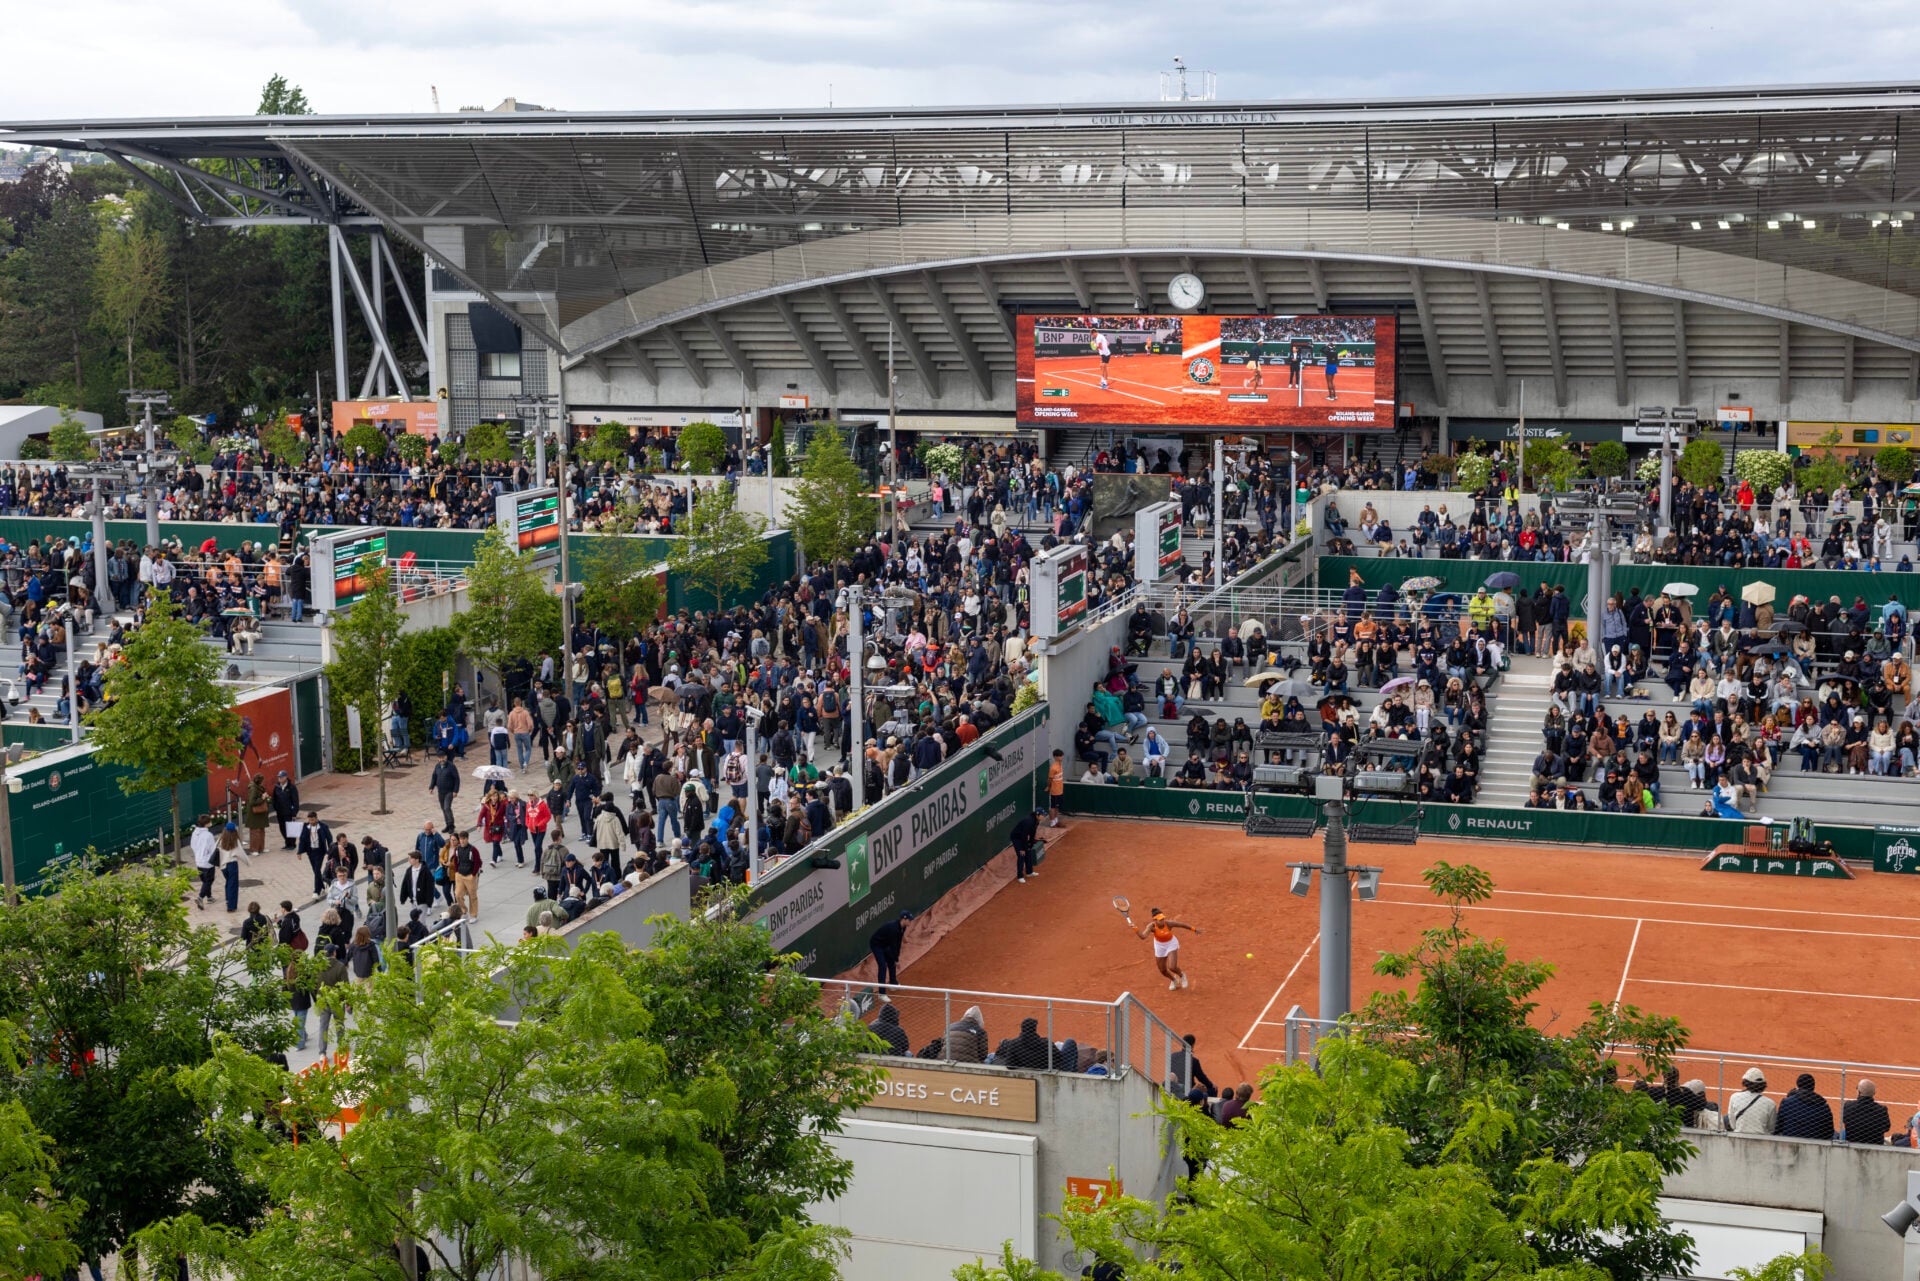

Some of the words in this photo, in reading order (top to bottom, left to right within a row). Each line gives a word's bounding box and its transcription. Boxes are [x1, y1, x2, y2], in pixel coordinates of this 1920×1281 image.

[1091, 115, 1133, 125] COURT
[1043, 333, 1064, 343] BNP
[1506, 427, 1545, 437] LAOSTE
[988, 761, 1000, 781] BNP
[1001, 746, 1024, 773] PARIBAS
[1206, 802, 1269, 816] RENALT
[873, 824, 903, 875] BNP
[912, 781, 967, 848] PARIBAS
[1467, 817, 1533, 830] RENAULT
[924, 859, 936, 880] BNP
[936, 843, 959, 871] PARIBAS
[770, 905, 788, 931] BNP
[790, 881, 824, 920] PARIBAS
[855, 910, 869, 931] BNP
[869, 891, 895, 921] PARIBAS
[950, 1087, 999, 1106] CAFÉ
